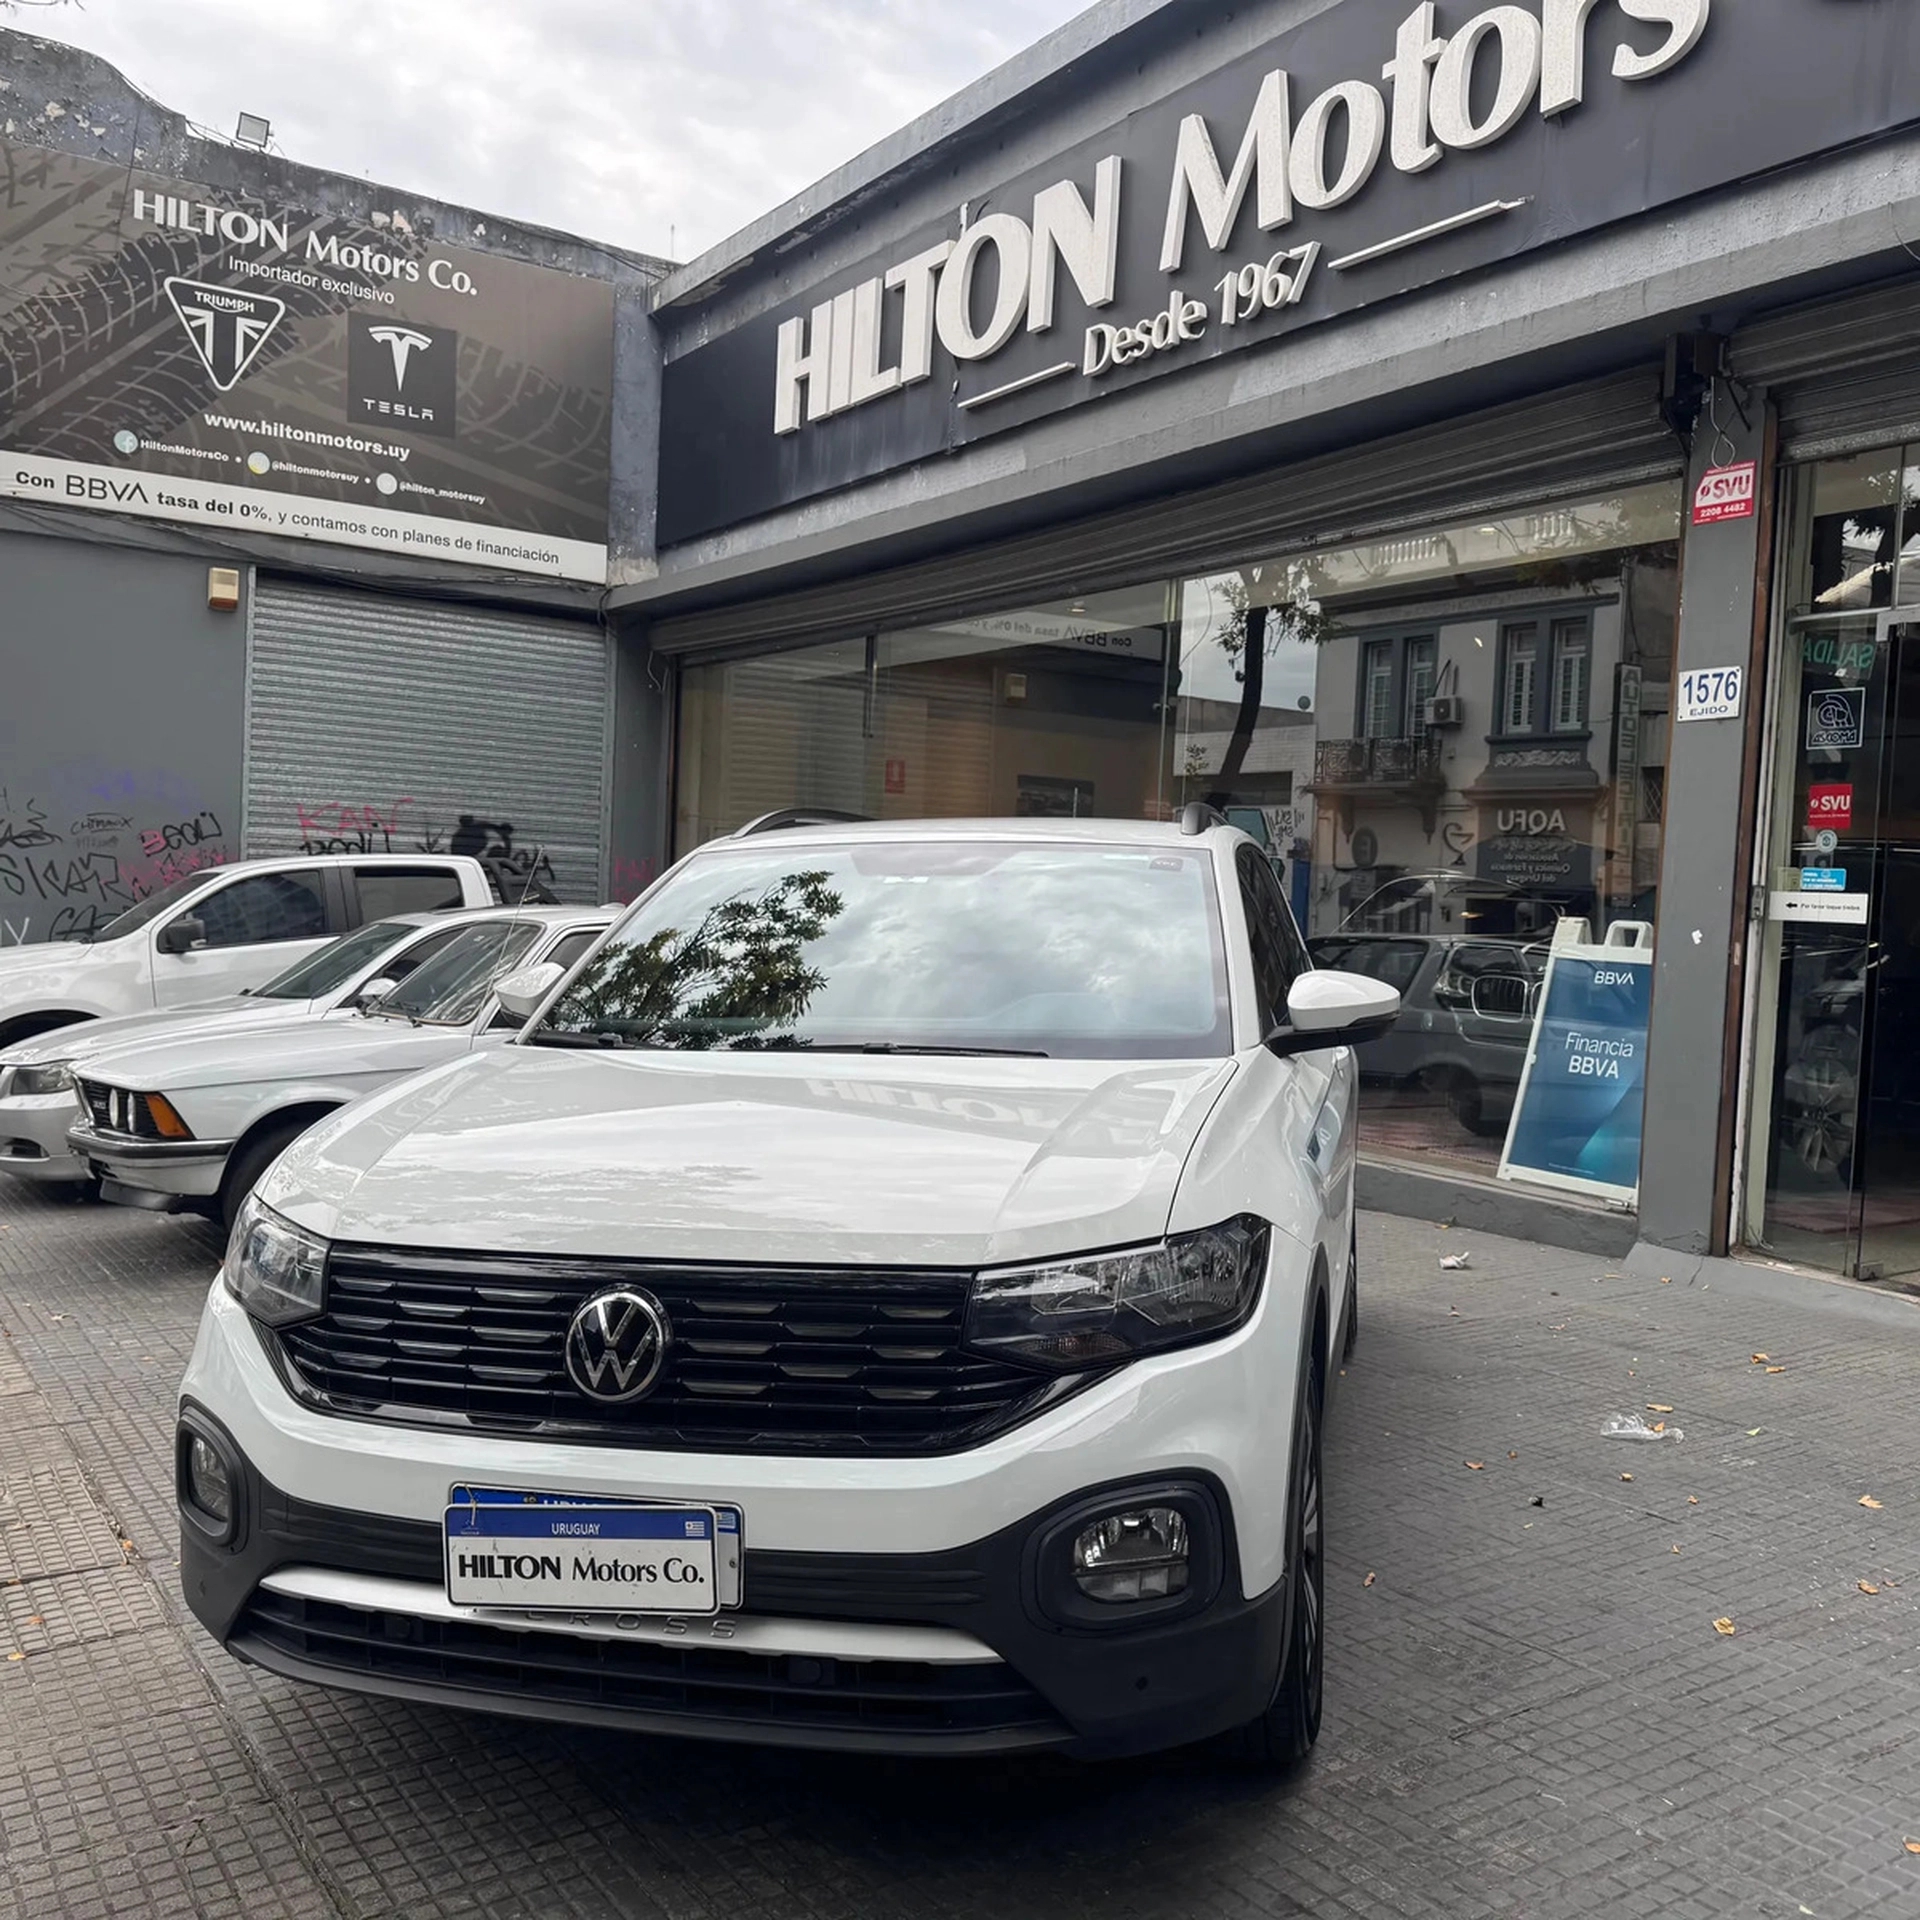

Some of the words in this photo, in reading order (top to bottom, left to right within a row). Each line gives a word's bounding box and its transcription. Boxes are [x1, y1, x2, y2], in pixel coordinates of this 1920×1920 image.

[133, 189, 288, 253] HILTON
[305, 230, 420, 283] Motors
[428, 260, 478, 296] Co.
[229, 255, 318, 288] Importador
[322, 275, 395, 304] exclusivo
[194, 291, 254, 313] TRIUMPH
[774, 155, 1122, 436] HILTON
[1083, 290, 1207, 377] Desde
[1214, 241, 1322, 325] 1967
[363, 398, 434, 421] TESLA
[204, 412, 410, 461] www.hiltonmotors.uy
[140, 439, 229, 462] HiltonMotorsCo
[272, 460, 359, 484] @hiltonmotorsuy
[400, 481, 486, 505] @hilton_motorsuy
[1713, 475, 1751, 499] SVU
[16, 471, 55, 488] Con
[66, 474, 149, 504] BBVA
[157, 492, 199, 510] tasa
[205, 499, 233, 514] del
[278, 511, 288, 525] y
[292, 513, 367, 534] contamos
[371, 525, 399, 539] con
[403, 528, 451, 547] planes
[454, 536, 473, 550] de
[476, 539, 560, 564] financiación
[1683, 671, 1738, 704] 1576
[1689, 705, 1728, 716] EJIDO
[1820, 795, 1851, 811] SVU
[1594, 971, 1634, 985] BBVA
[1565, 1032, 1634, 1057] Financia
[1568, 1055, 1619, 1079] BBVA
[551, 1522, 600, 1536] URUGUAY
[458, 1554, 561, 1580] HILTON
[572, 1556, 657, 1583] Motors
[664, 1557, 705, 1583] Co.
